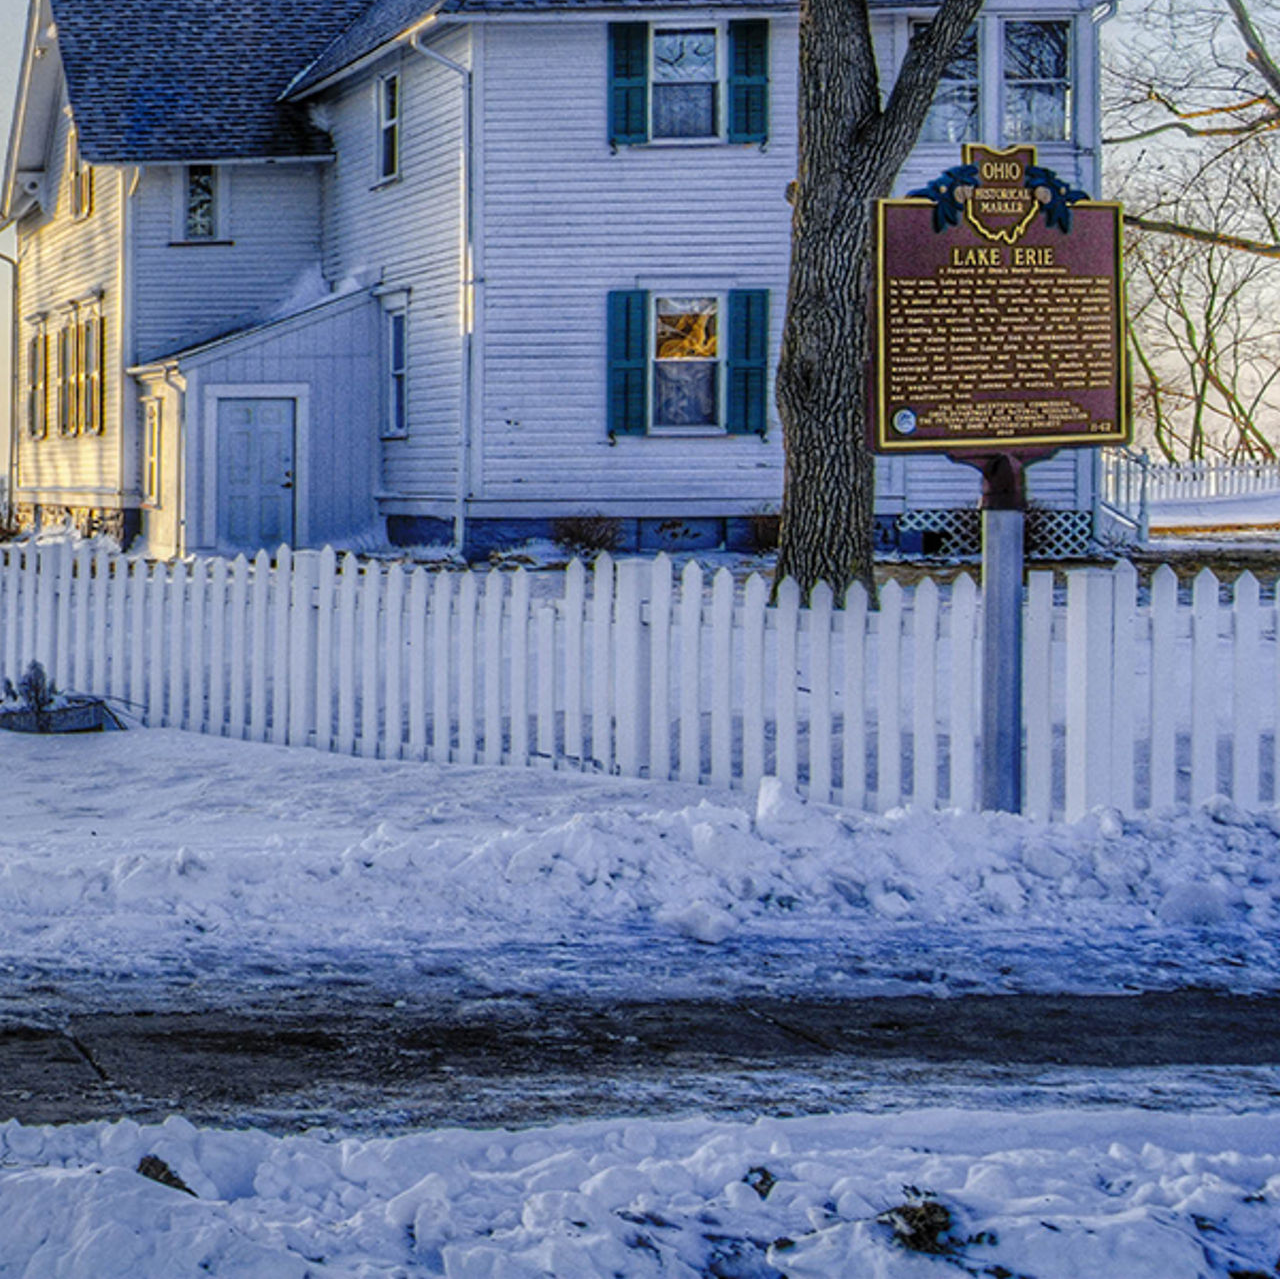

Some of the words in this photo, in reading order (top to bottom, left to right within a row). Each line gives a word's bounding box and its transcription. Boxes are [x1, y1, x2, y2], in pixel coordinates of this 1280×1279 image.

[982, 162, 1021, 179] OHIO
[975, 188, 1031, 199] HISTORICAL
[981, 202, 1023, 213] MARKER
[953, 248, 1001, 266] LAKE
[1014, 248, 1054, 266] ERIE
